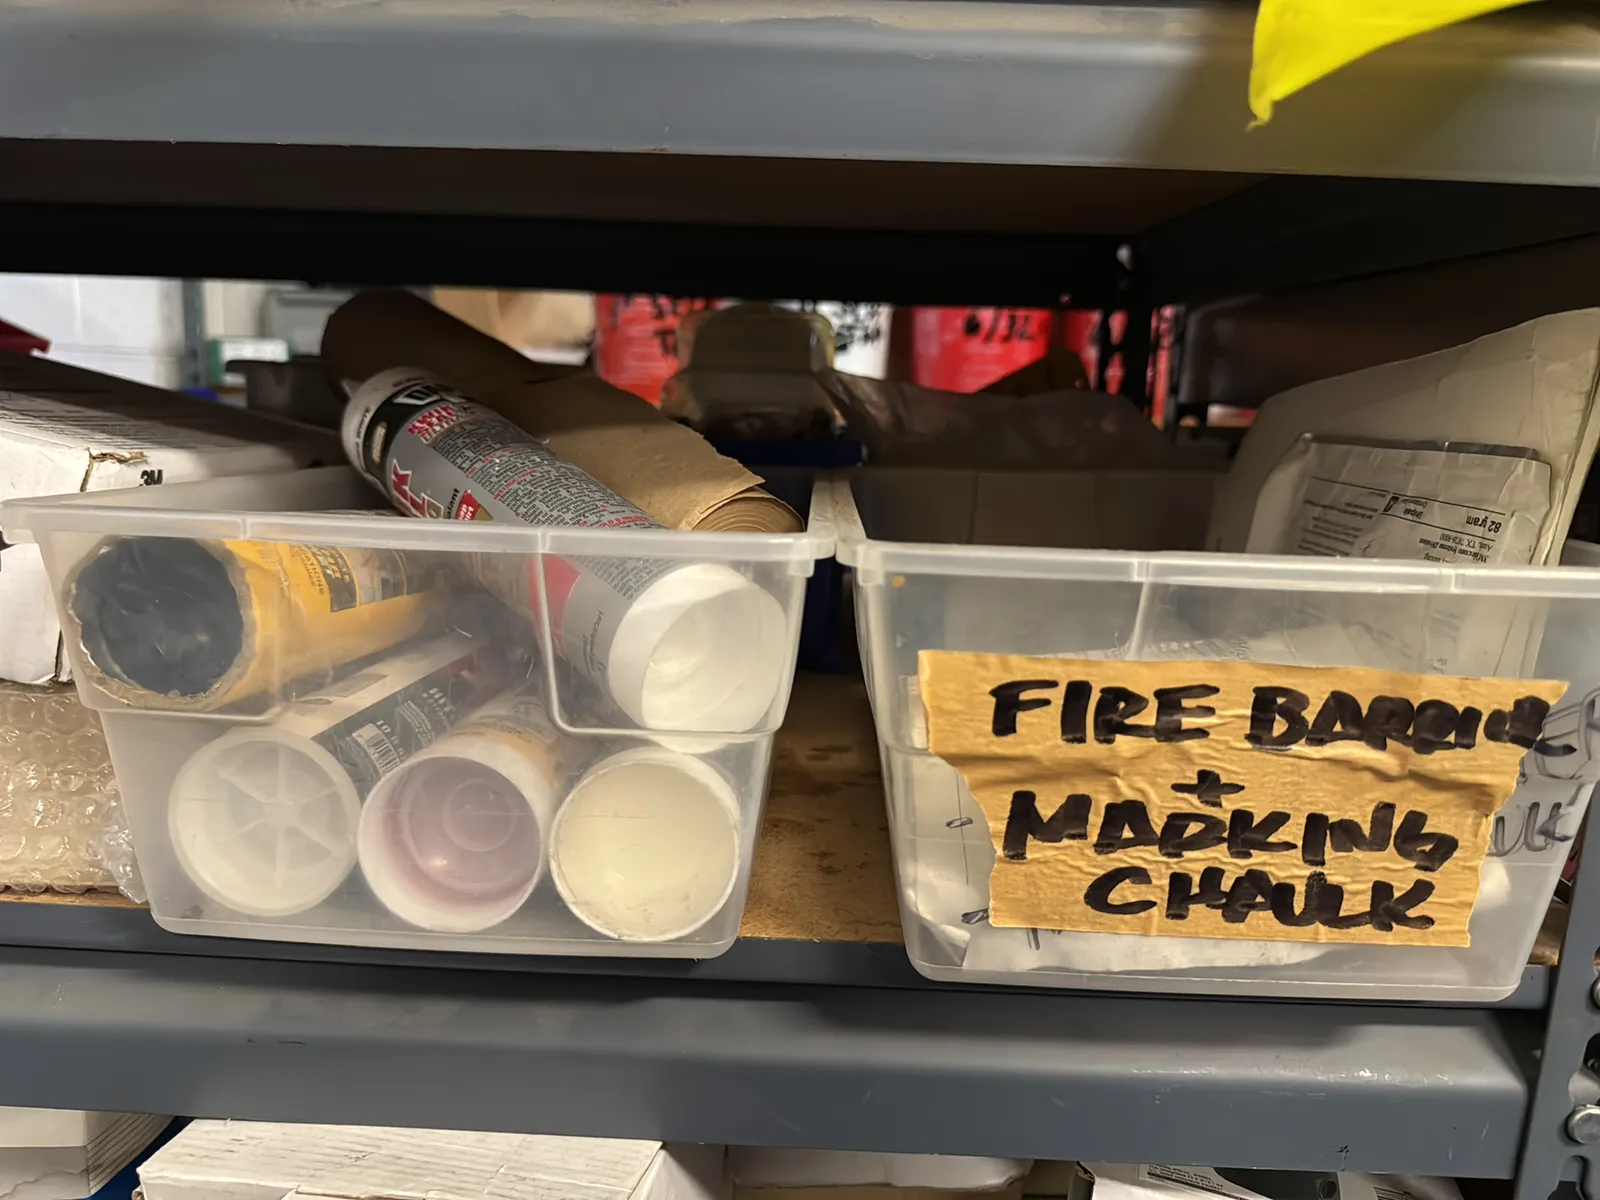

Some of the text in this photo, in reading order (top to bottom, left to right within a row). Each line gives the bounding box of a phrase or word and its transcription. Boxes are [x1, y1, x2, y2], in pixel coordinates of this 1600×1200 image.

[1487, 518, 1502, 533] 82
[989, 680, 1221, 744] FIRE
[1170, 768, 1246, 808] +
[1002, 790, 1459, 872] MARKING
